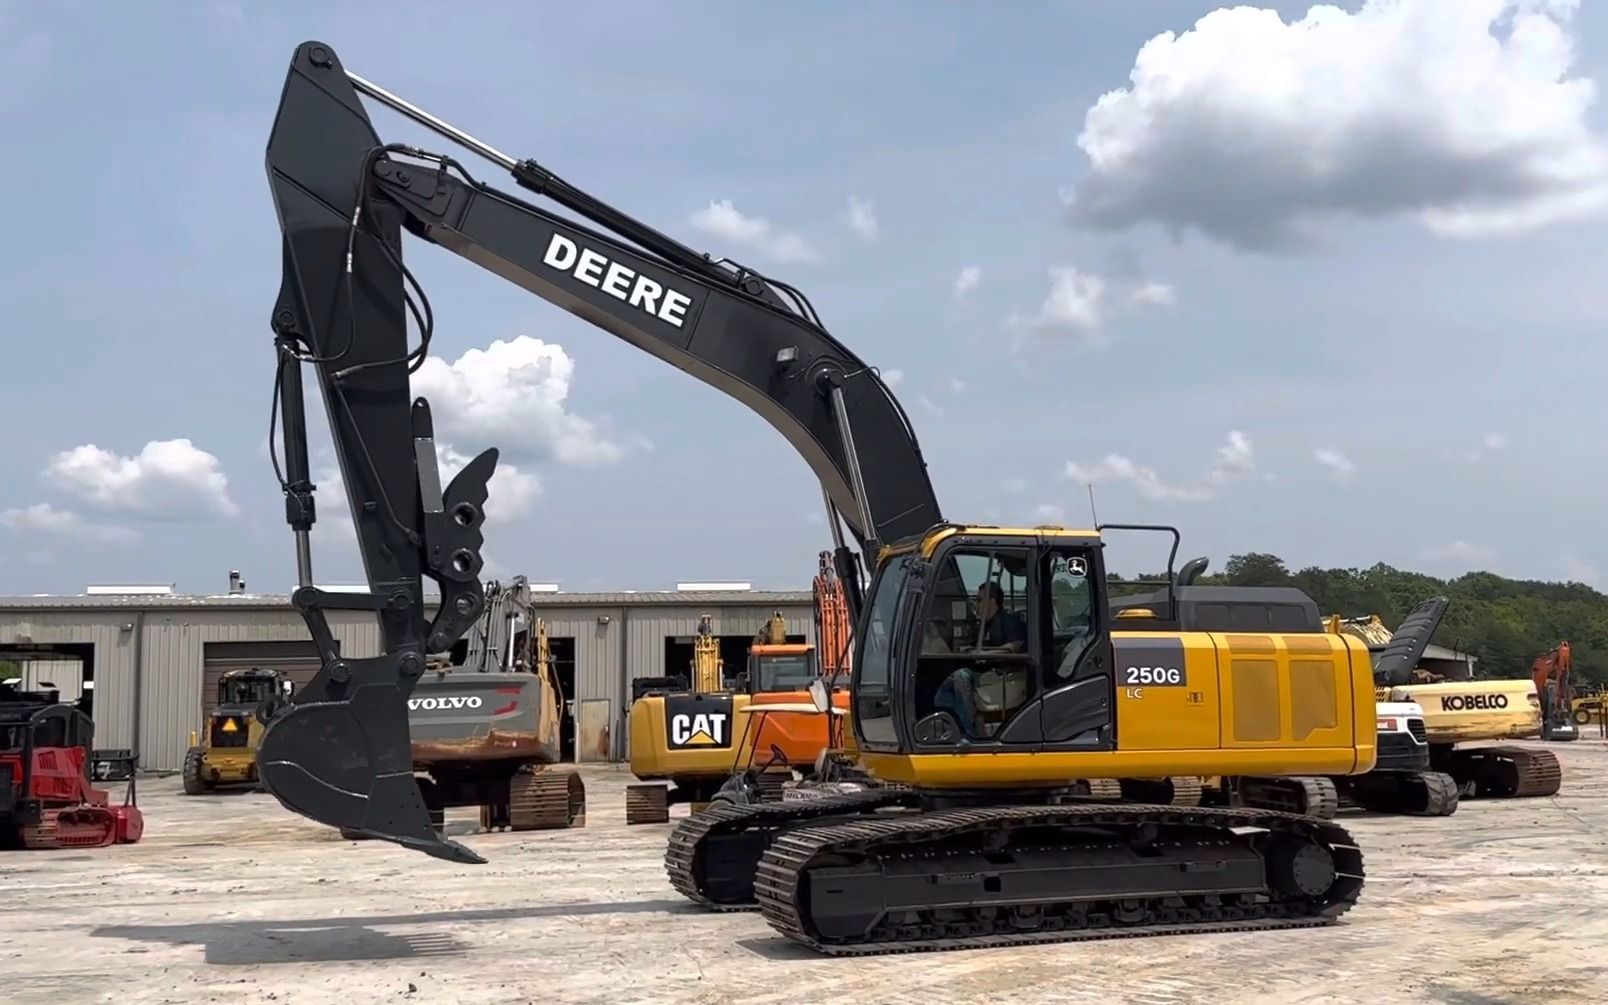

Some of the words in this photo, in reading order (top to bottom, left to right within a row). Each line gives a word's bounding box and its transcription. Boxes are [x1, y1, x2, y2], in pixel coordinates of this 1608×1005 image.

[543, 233, 691, 328] DEERE
[1126, 667, 1180, 684] 250G
[1126, 688, 1143, 699] LC
[407, 696, 482, 711] VOLVO
[1441, 694, 1508, 711] KOBELCO
[672, 714, 726, 745] CAT
